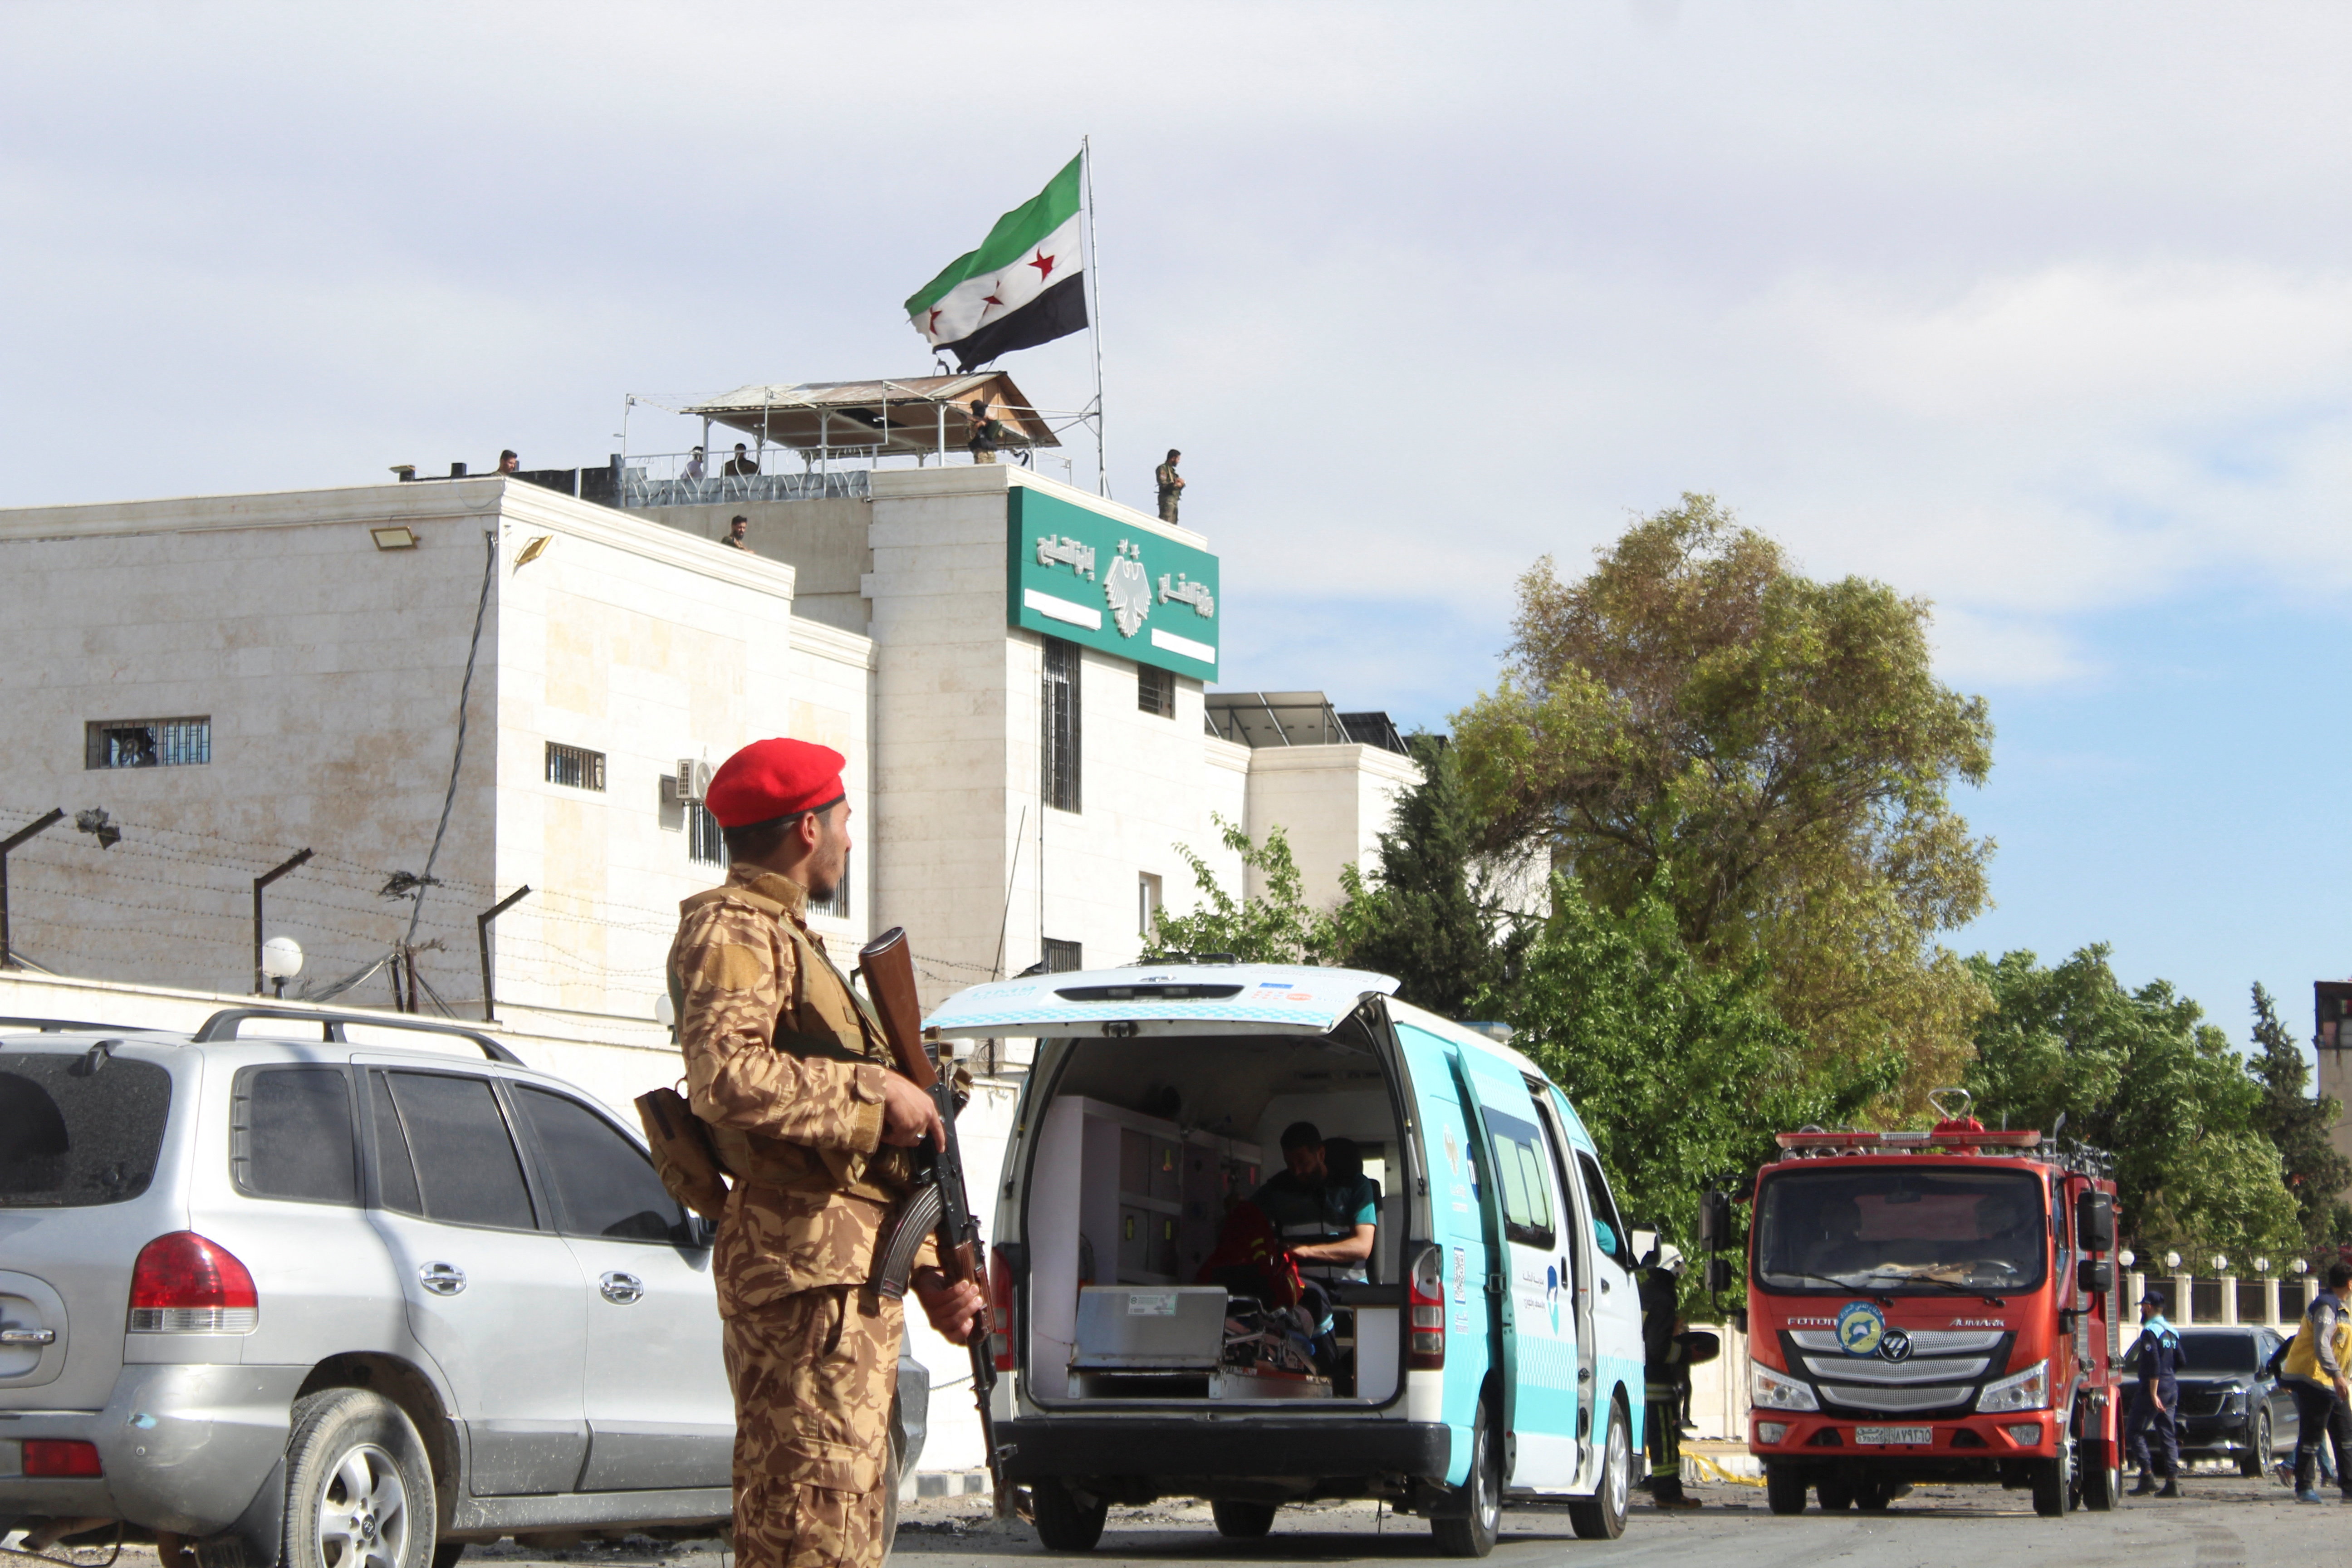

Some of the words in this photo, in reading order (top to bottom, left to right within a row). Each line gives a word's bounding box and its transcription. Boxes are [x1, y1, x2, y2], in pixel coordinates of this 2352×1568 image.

[1158, 573, 1197, 605] الدفاع
[1194, 583, 1215, 618] وزارة
[1788, 1318, 1837, 1326] FOTON
[1949, 1318, 2004, 1327] AUMARK
[2318, 1316, 2332, 1325] SCD
